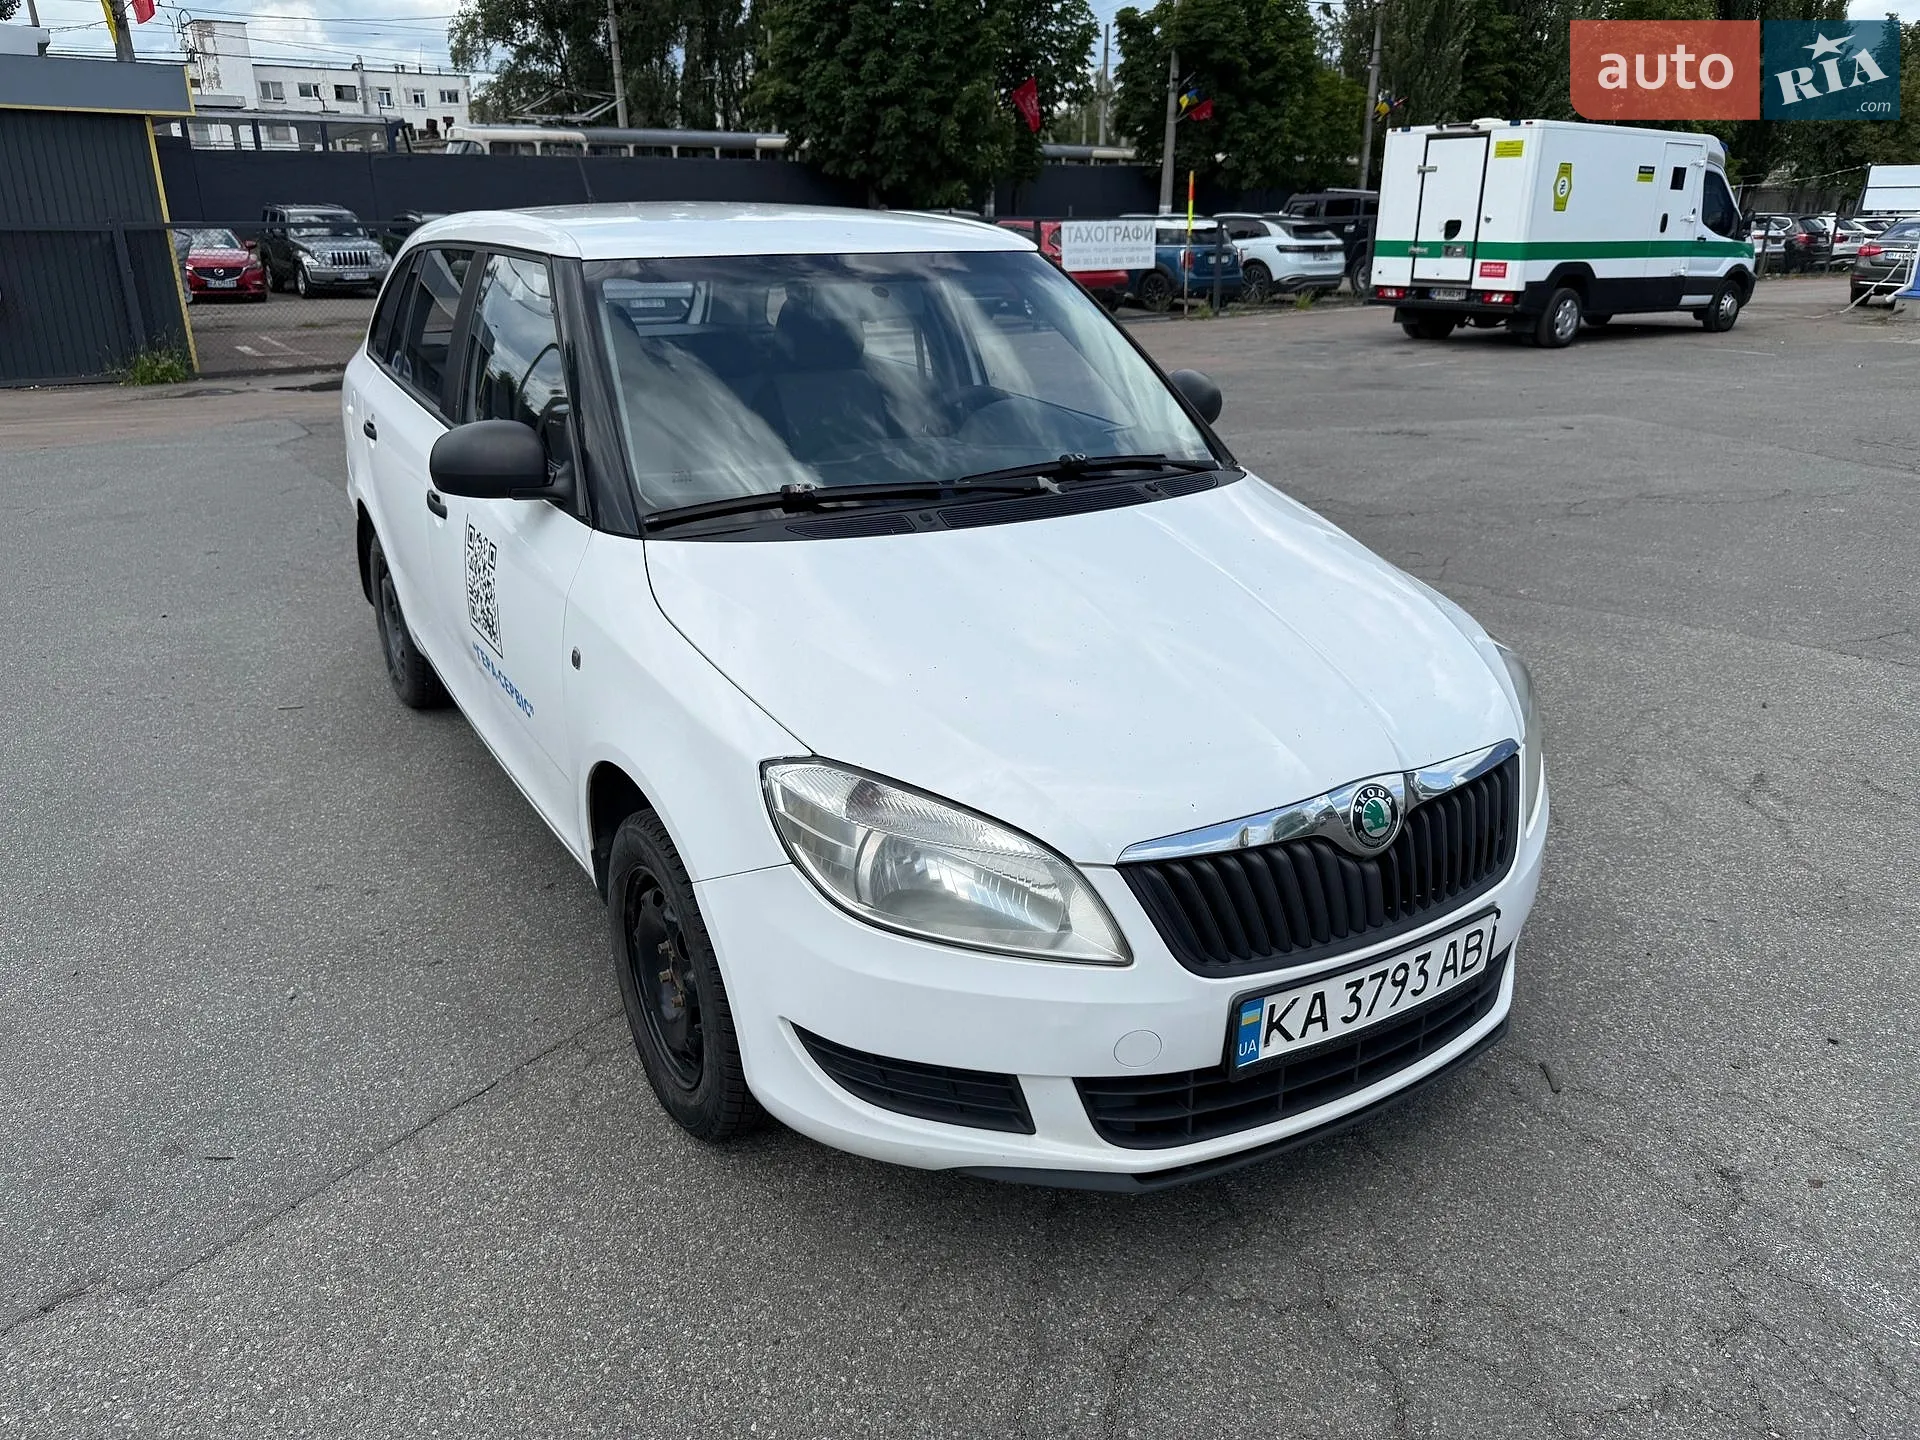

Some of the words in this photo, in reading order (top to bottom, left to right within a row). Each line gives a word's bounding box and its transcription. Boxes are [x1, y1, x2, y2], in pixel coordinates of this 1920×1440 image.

[1065, 225, 1153, 243] ТАХОГРАФИ
[1263, 991, 1329, 1048] KA
[1340, 951, 1432, 1024] 3793
[1437, 928, 1484, 987] AB
[1238, 1040, 1257, 1057] UA
